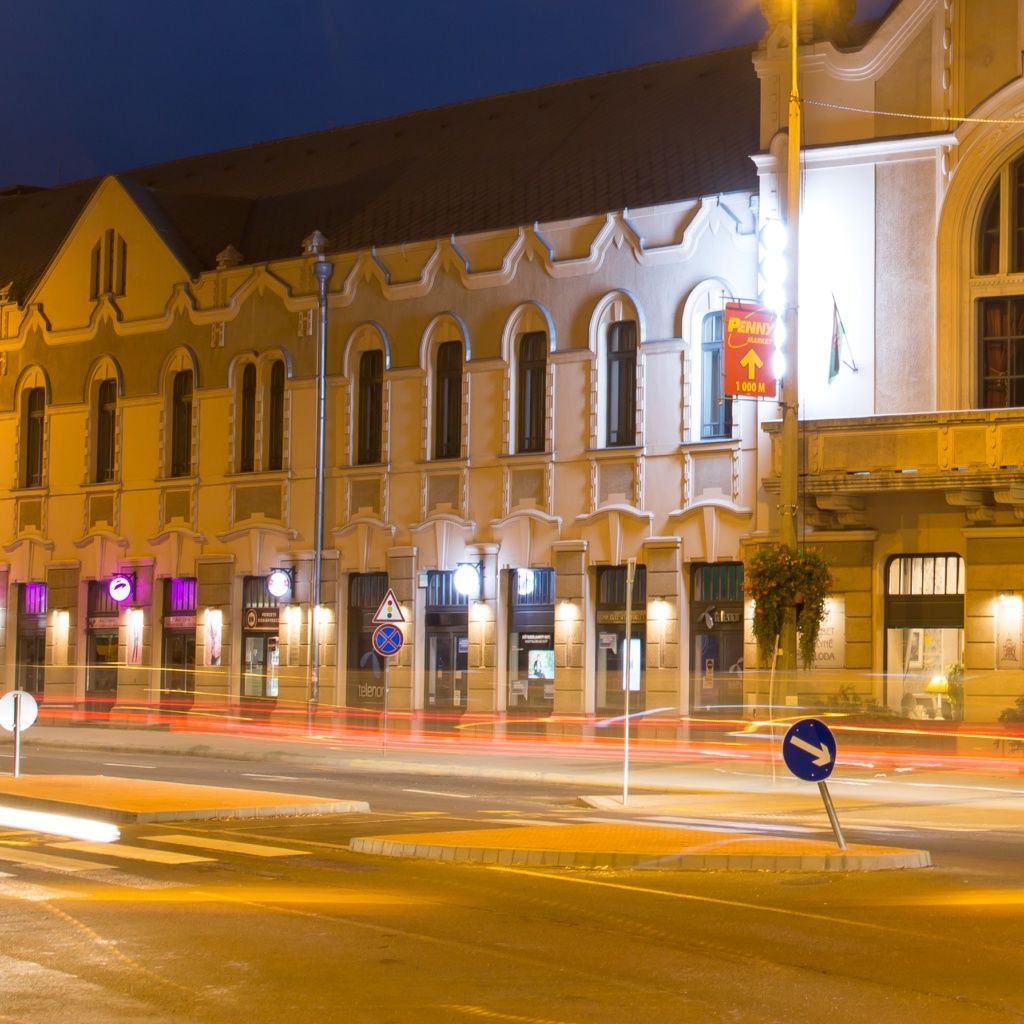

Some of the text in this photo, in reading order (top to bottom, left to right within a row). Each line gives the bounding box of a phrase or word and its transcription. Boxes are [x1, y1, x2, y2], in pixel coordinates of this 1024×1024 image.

[728, 317, 774, 336] PENNY
[747, 337, 773, 345] MARKET
[758, 382, 766, 393] M
[358, 682, 385, 698] telenor
